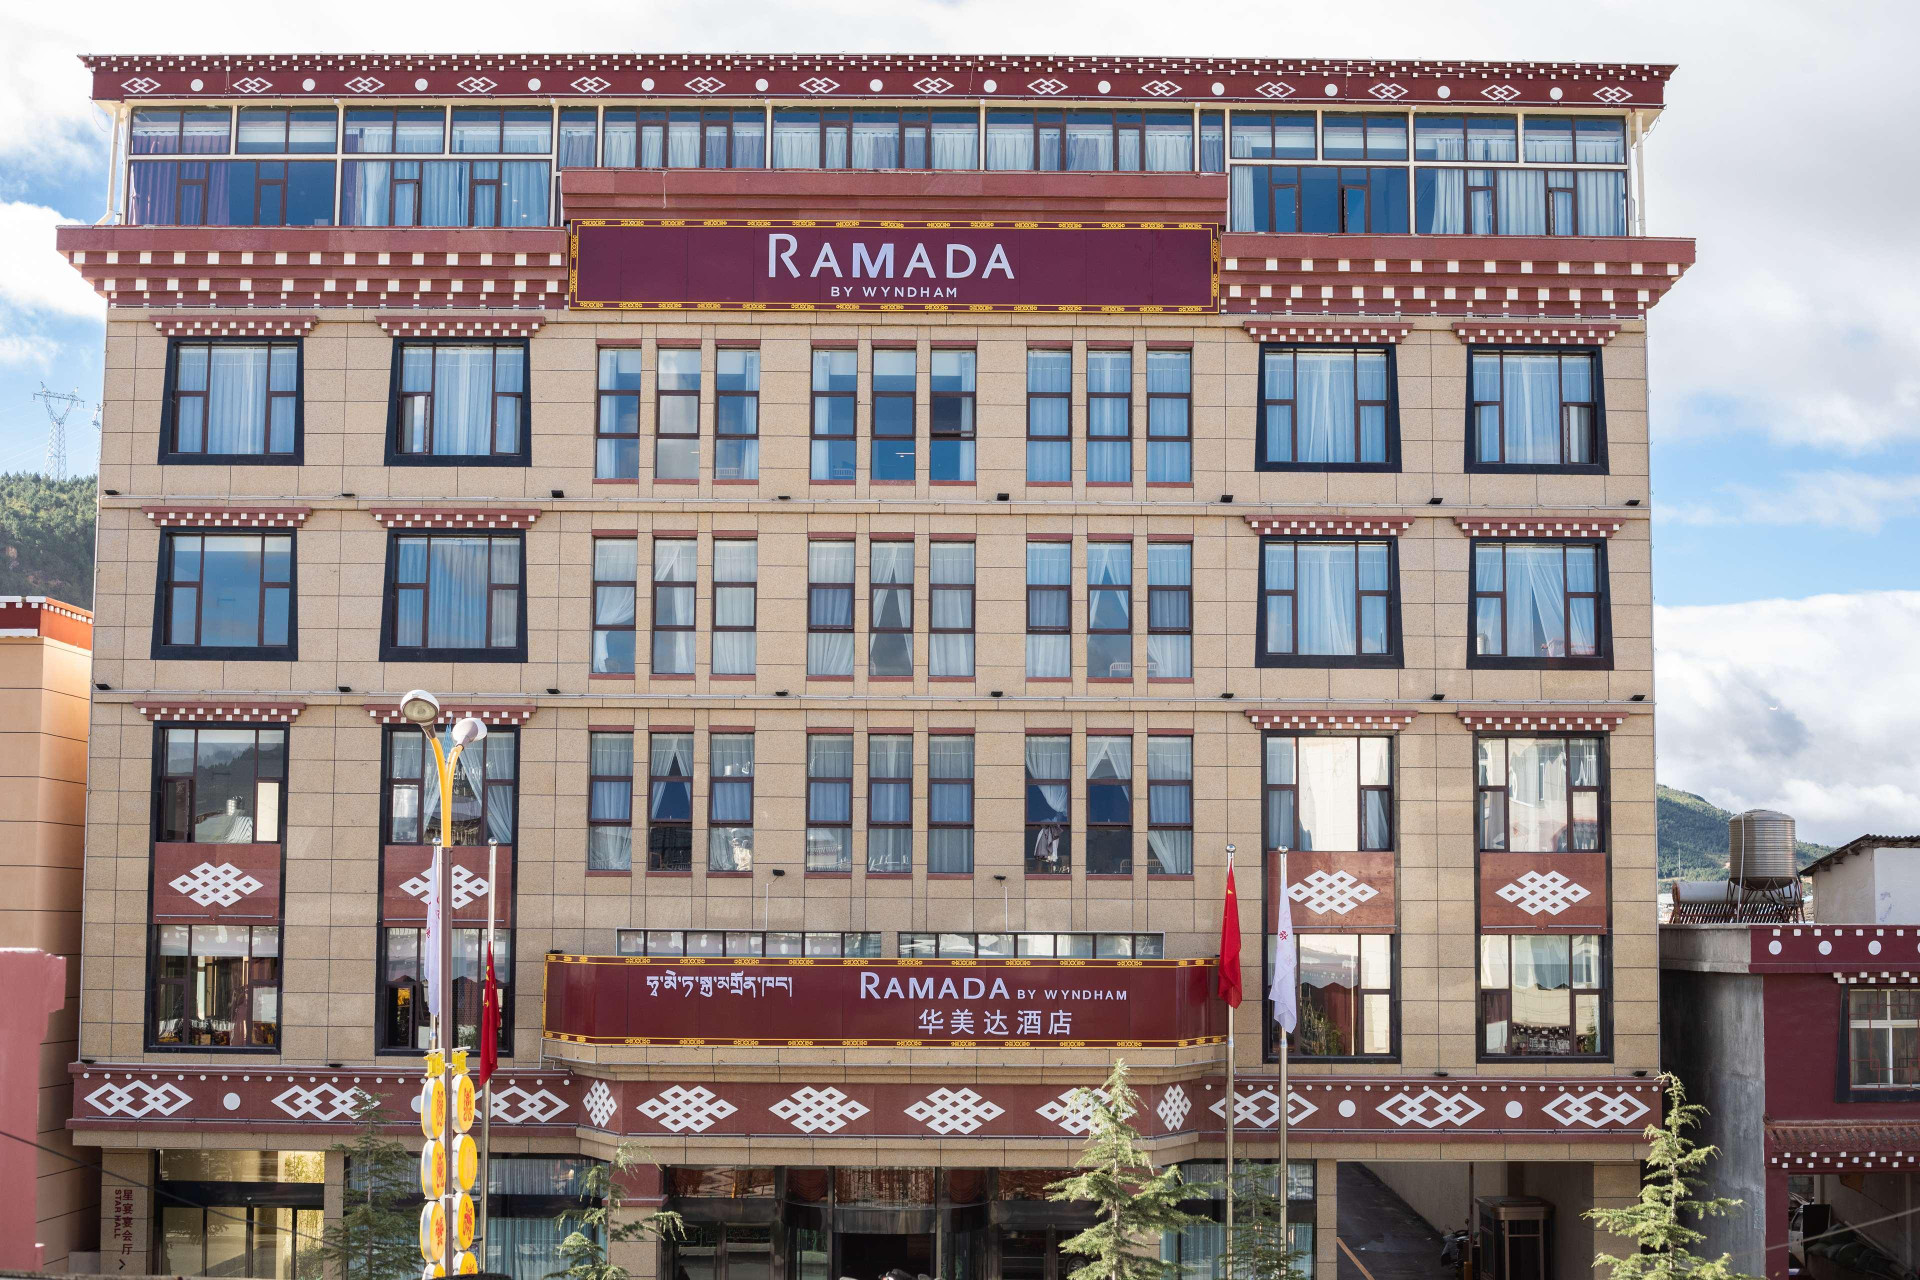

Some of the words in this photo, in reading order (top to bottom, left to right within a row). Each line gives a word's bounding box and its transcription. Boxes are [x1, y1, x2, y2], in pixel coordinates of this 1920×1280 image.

[769, 233, 1015, 279] RAMADA
[830, 286, 853, 297] BY
[862, 286, 957, 298] WYNDHAM
[860, 971, 1010, 1000] RAMADA
[1017, 989, 1037, 1000] BY
[1045, 989, 1127, 1001] WYNDHAM
[918, 1008, 1073, 1035] 华美达酒店
[114, 1189, 122, 1213] STAR
[122, 1189, 133, 1255] 星宴宴会厅
